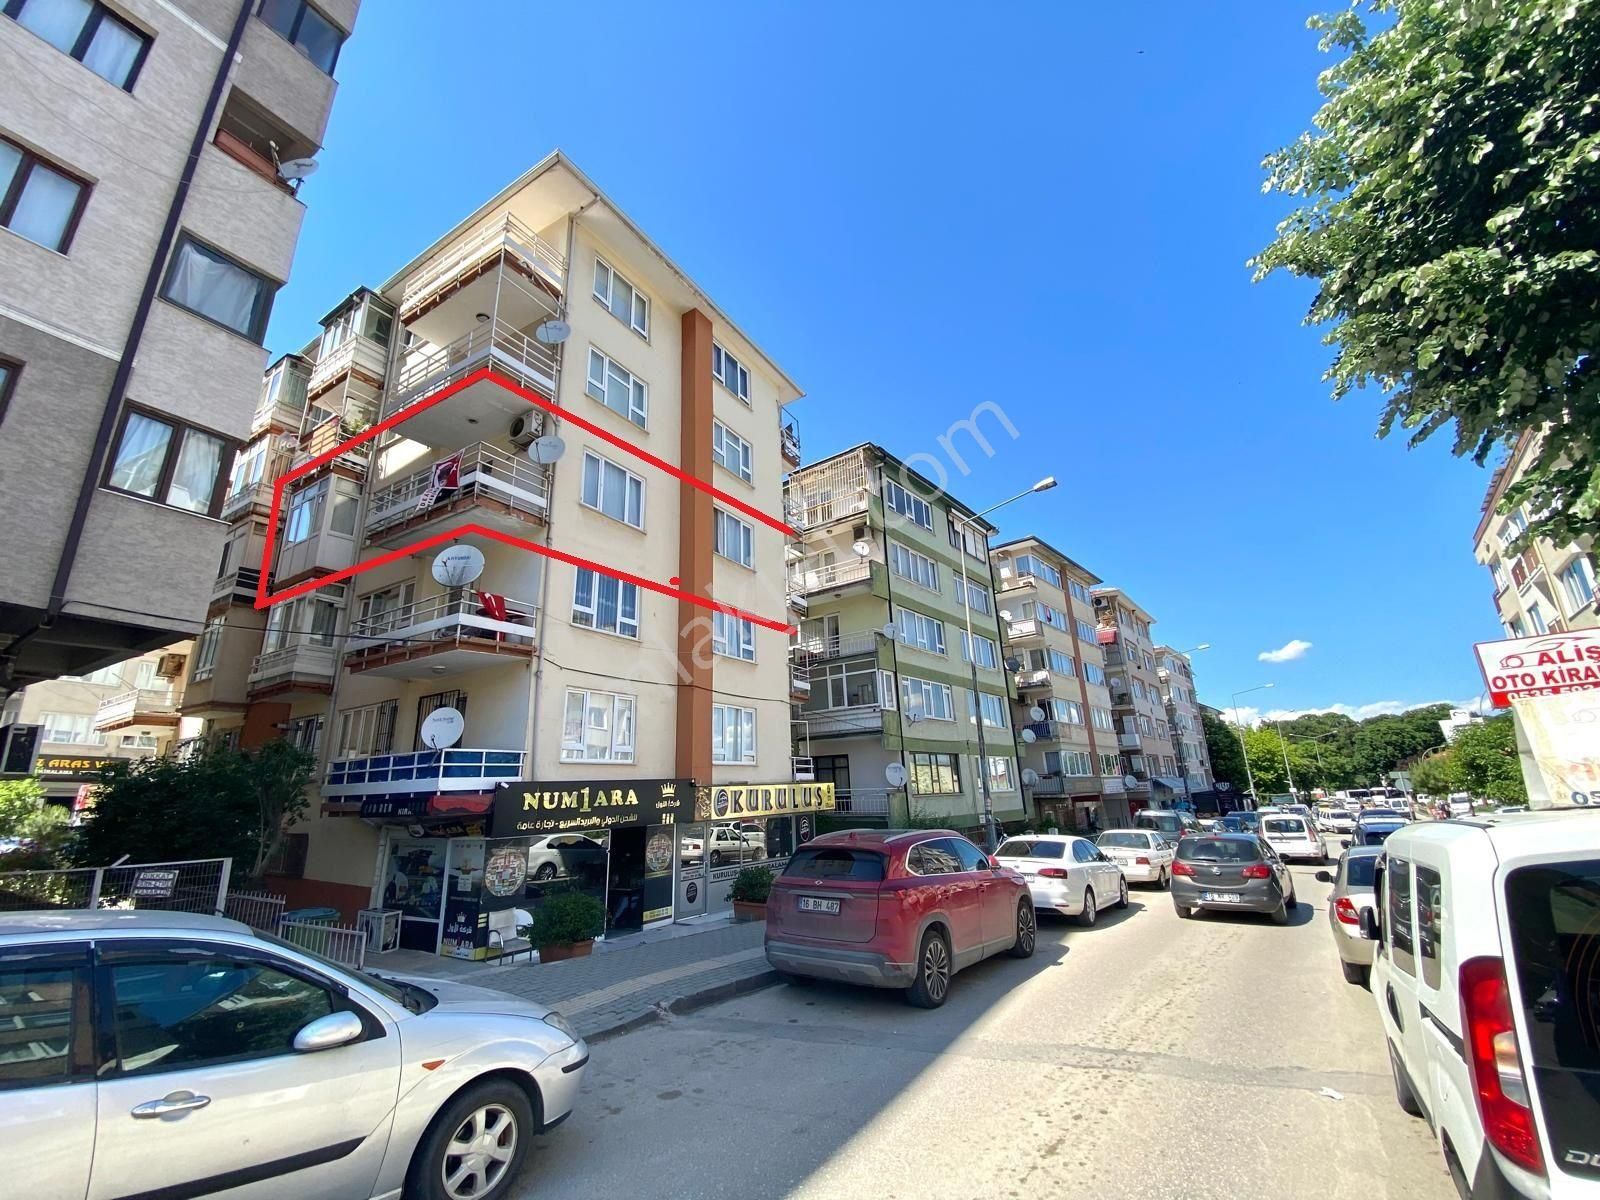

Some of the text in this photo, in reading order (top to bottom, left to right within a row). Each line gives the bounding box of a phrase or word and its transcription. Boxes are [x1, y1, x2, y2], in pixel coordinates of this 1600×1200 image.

[1491, 672, 1537, 690] OTO
[48, 759, 91, 769] ARAS
[812, 900, 822, 910] BH
[825, 901, 839, 911] 487
